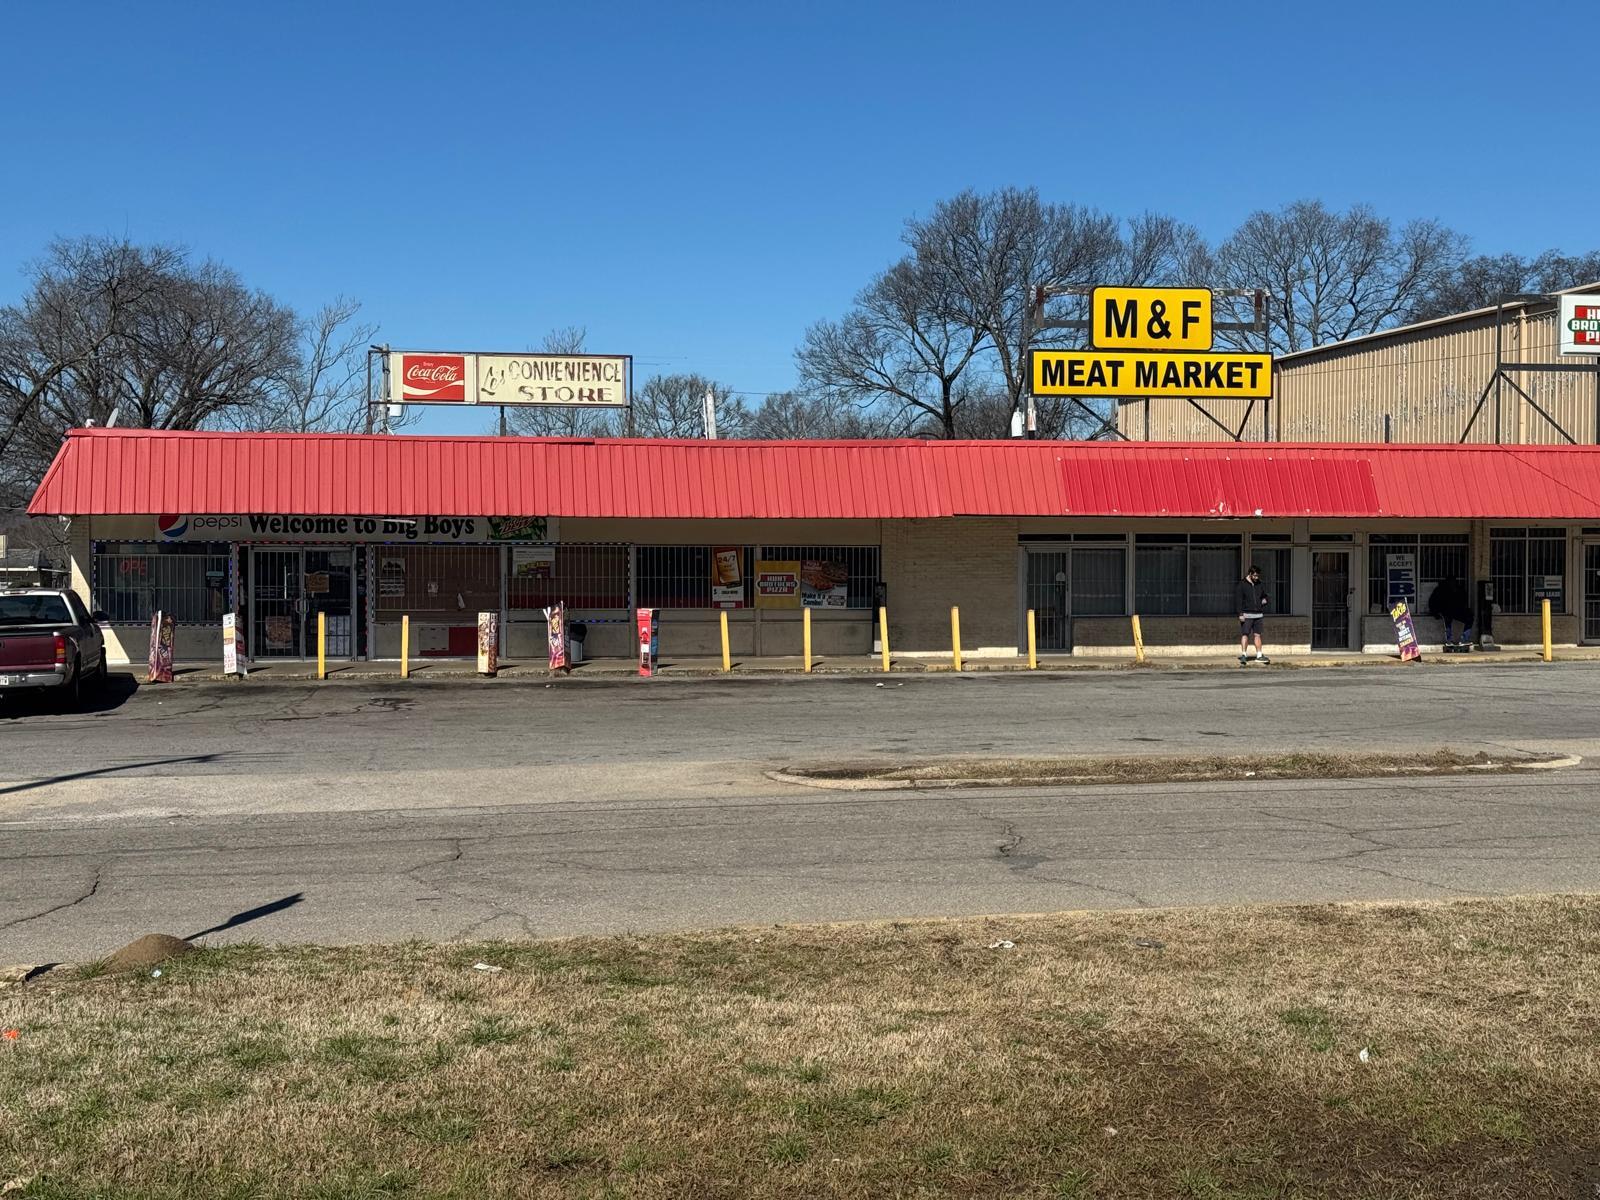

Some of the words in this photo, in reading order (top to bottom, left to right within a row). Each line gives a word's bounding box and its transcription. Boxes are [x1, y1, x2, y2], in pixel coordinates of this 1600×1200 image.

[1105, 299, 1138, 338] M
[1147, 299, 1172, 340] &
[1181, 300, 1202, 339] F
[406, 364, 460, 382] Coca-Cola
[1041, 359, 1124, 387] MEAT
[1135, 361, 1263, 389] MARKET
[518, 384, 613, 402] STORE
[193, 517, 242, 531] pepsi
[249, 515, 348, 534] Welcome
[353, 517, 377, 534] to
[383, 516, 418, 540] Big
[424, 515, 476, 539] Boys
